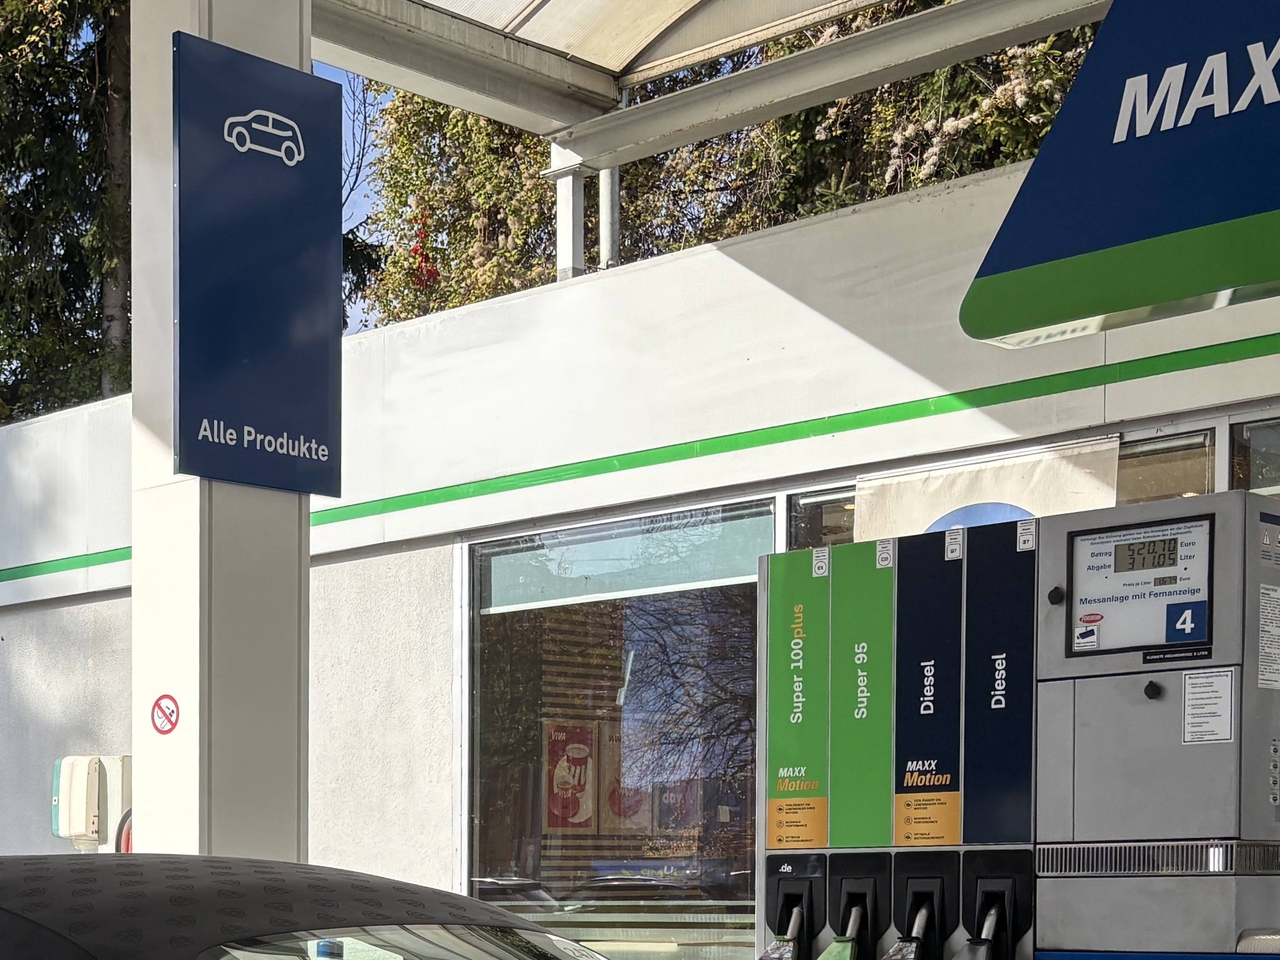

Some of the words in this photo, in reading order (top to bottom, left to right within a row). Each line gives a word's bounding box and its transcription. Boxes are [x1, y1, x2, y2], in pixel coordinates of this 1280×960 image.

[198, 418, 237, 446] Alle
[243, 425, 329, 461] Produkte
[1080, 595, 1129, 605] Messanlage
[1132, 592, 1146, 600] mit
[1148, 587, 1202, 598] Fernanzeige
[1175, 609, 1195, 634] 4
[854, 642, 868, 664] 95
[920, 660, 935, 715] Diesel
[991, 653, 1007, 709] Diesel
[790, 675, 806, 724] Super
[854, 669, 871, 719] Super
[778, 766, 807, 778] MAXX
[906, 760, 938, 772] MAXX
[776, 777, 819, 792] Motion
[903, 771, 951, 787] Motion
[778, 863, 793, 873] .de
